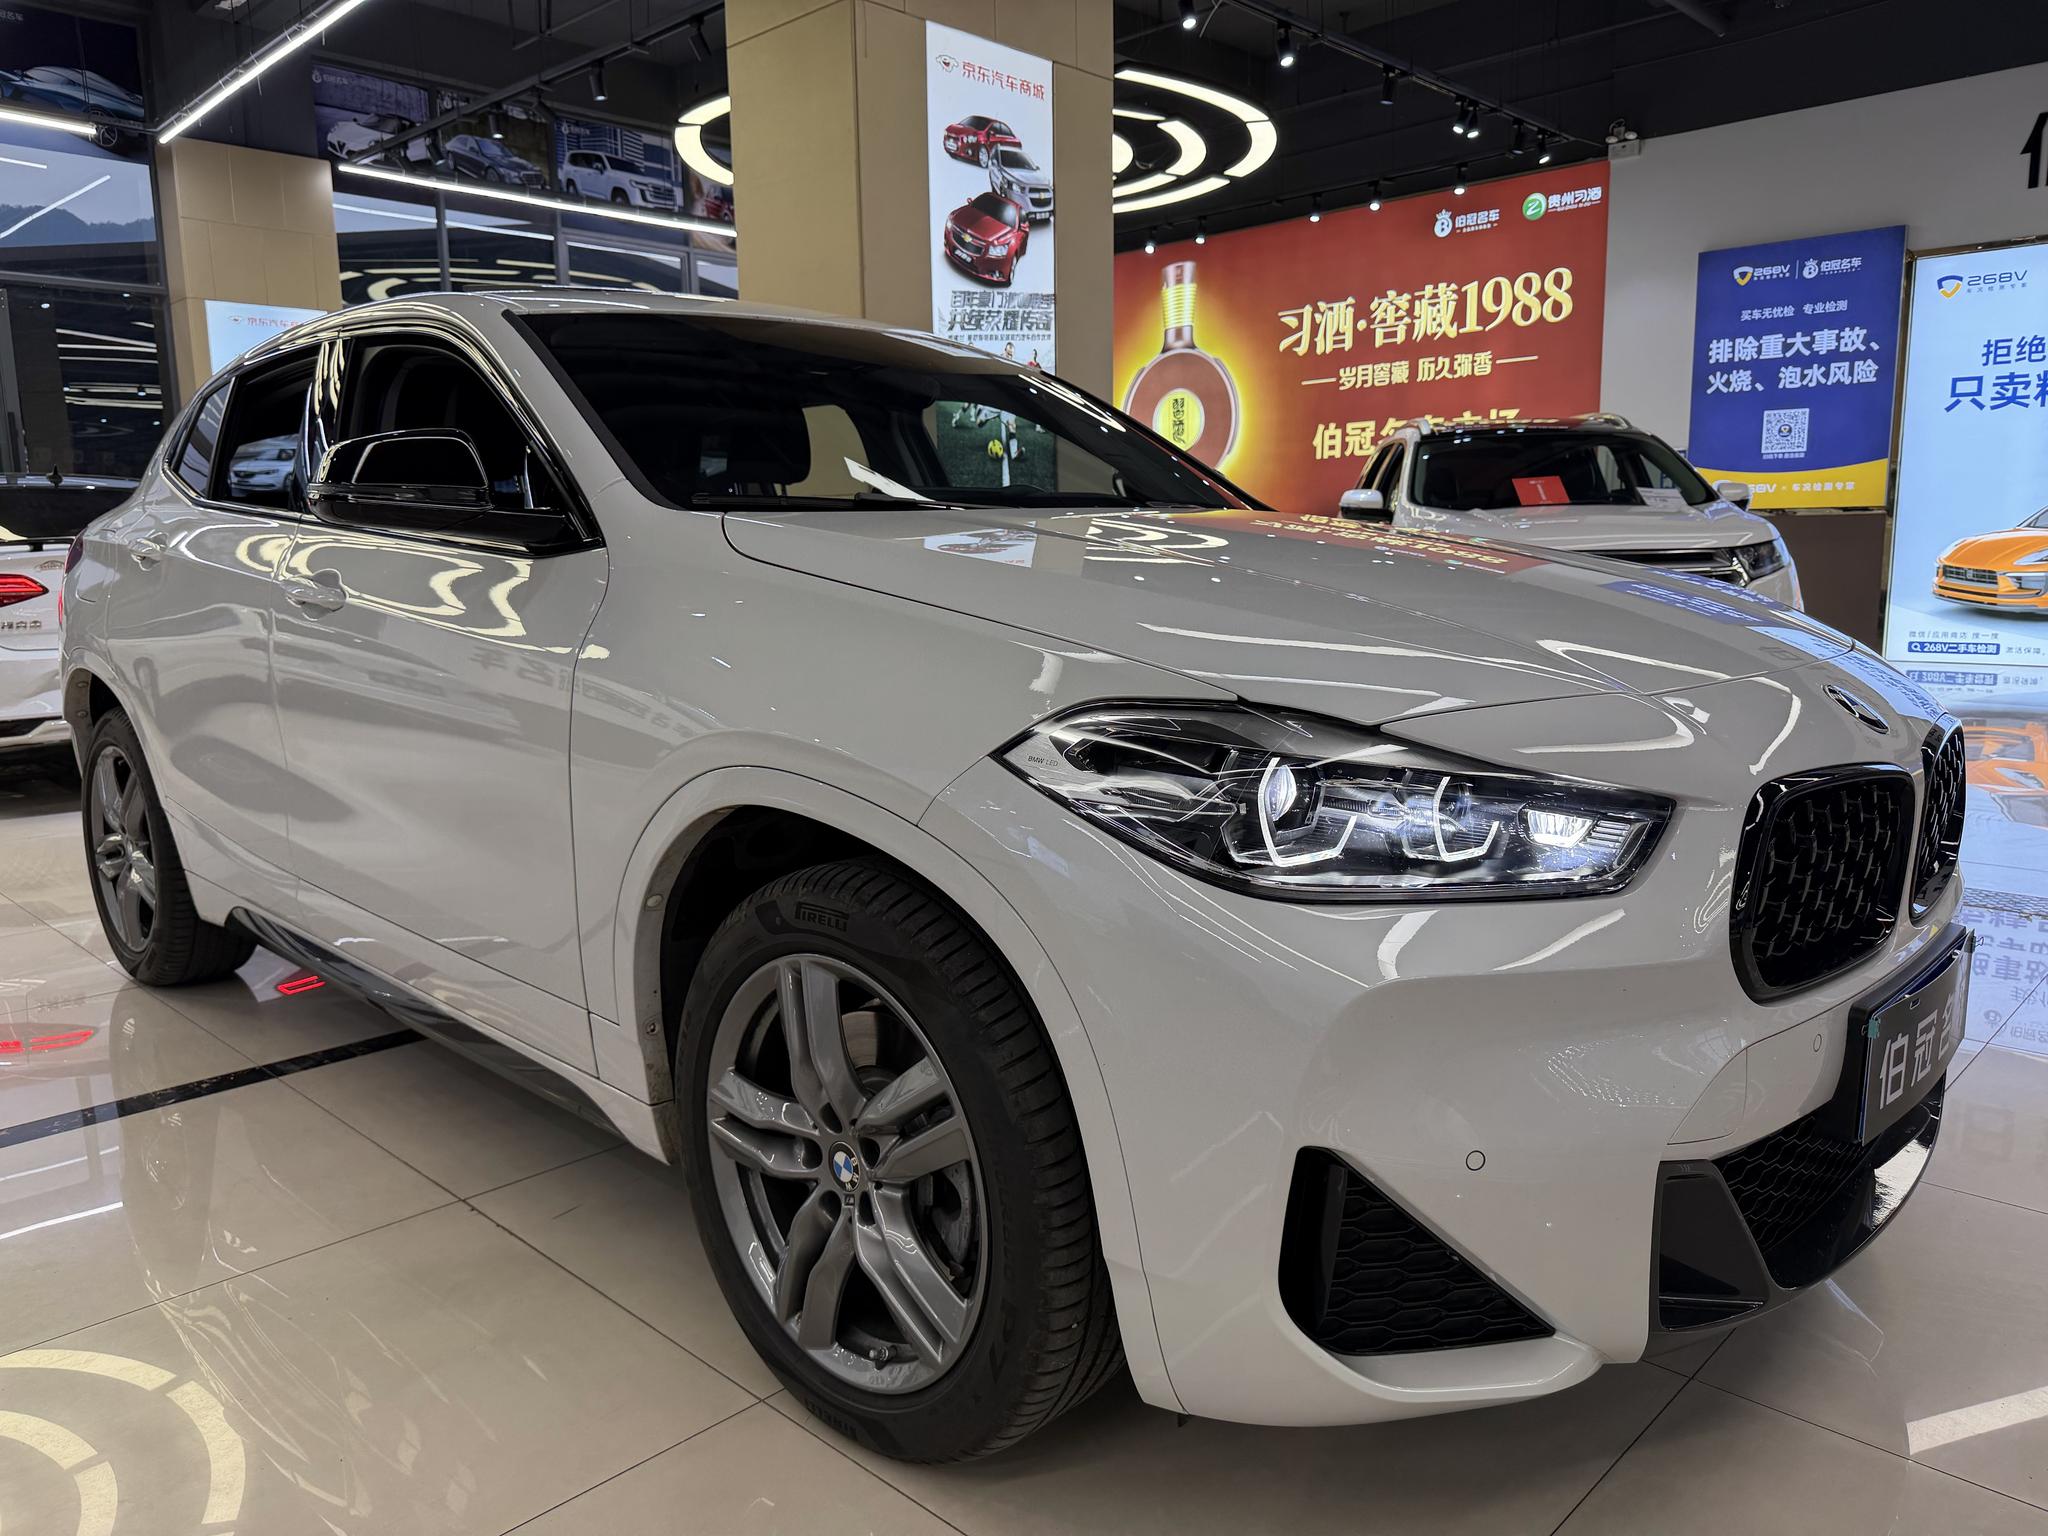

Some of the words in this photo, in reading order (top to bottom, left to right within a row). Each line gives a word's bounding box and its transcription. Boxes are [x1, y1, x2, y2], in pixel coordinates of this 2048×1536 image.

[961, 61, 1046, 100] 京东汽车商城
[1548, 186, 1602, 208] 贵州习酒
[1820, 257, 1862, 272] 伯冠名车
[1967, 270, 2028, 287] 268V
[1803, 300, 1848, 314] 专业检测
[1708, 326, 1880, 364] 排除重大事故、
[1981, 334, 2047, 367] 拒绝
[1338, 360, 1410, 391] 岁月窖藏
[1416, 351, 1493, 383] 历久弥香
[1923, 643, 1998, 655] 268V二手车检测
[794, 901, 850, 933] PIRELLI
